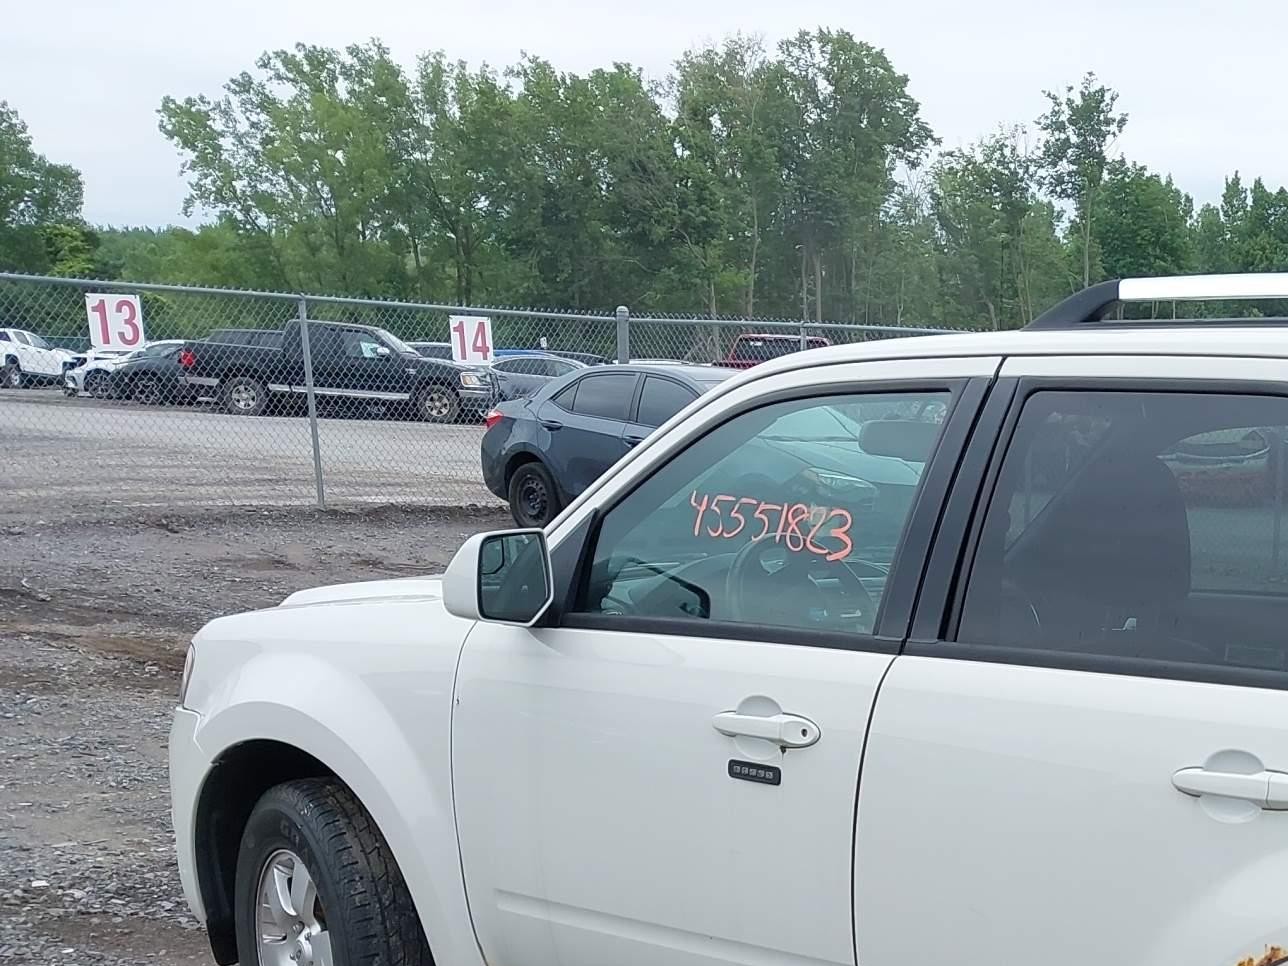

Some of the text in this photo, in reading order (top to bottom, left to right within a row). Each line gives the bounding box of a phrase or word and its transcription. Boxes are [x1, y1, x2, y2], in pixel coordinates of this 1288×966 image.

[90, 298, 140, 346] 13
[452, 320, 491, 361] 14
[690, 489, 854, 562] 45551823
